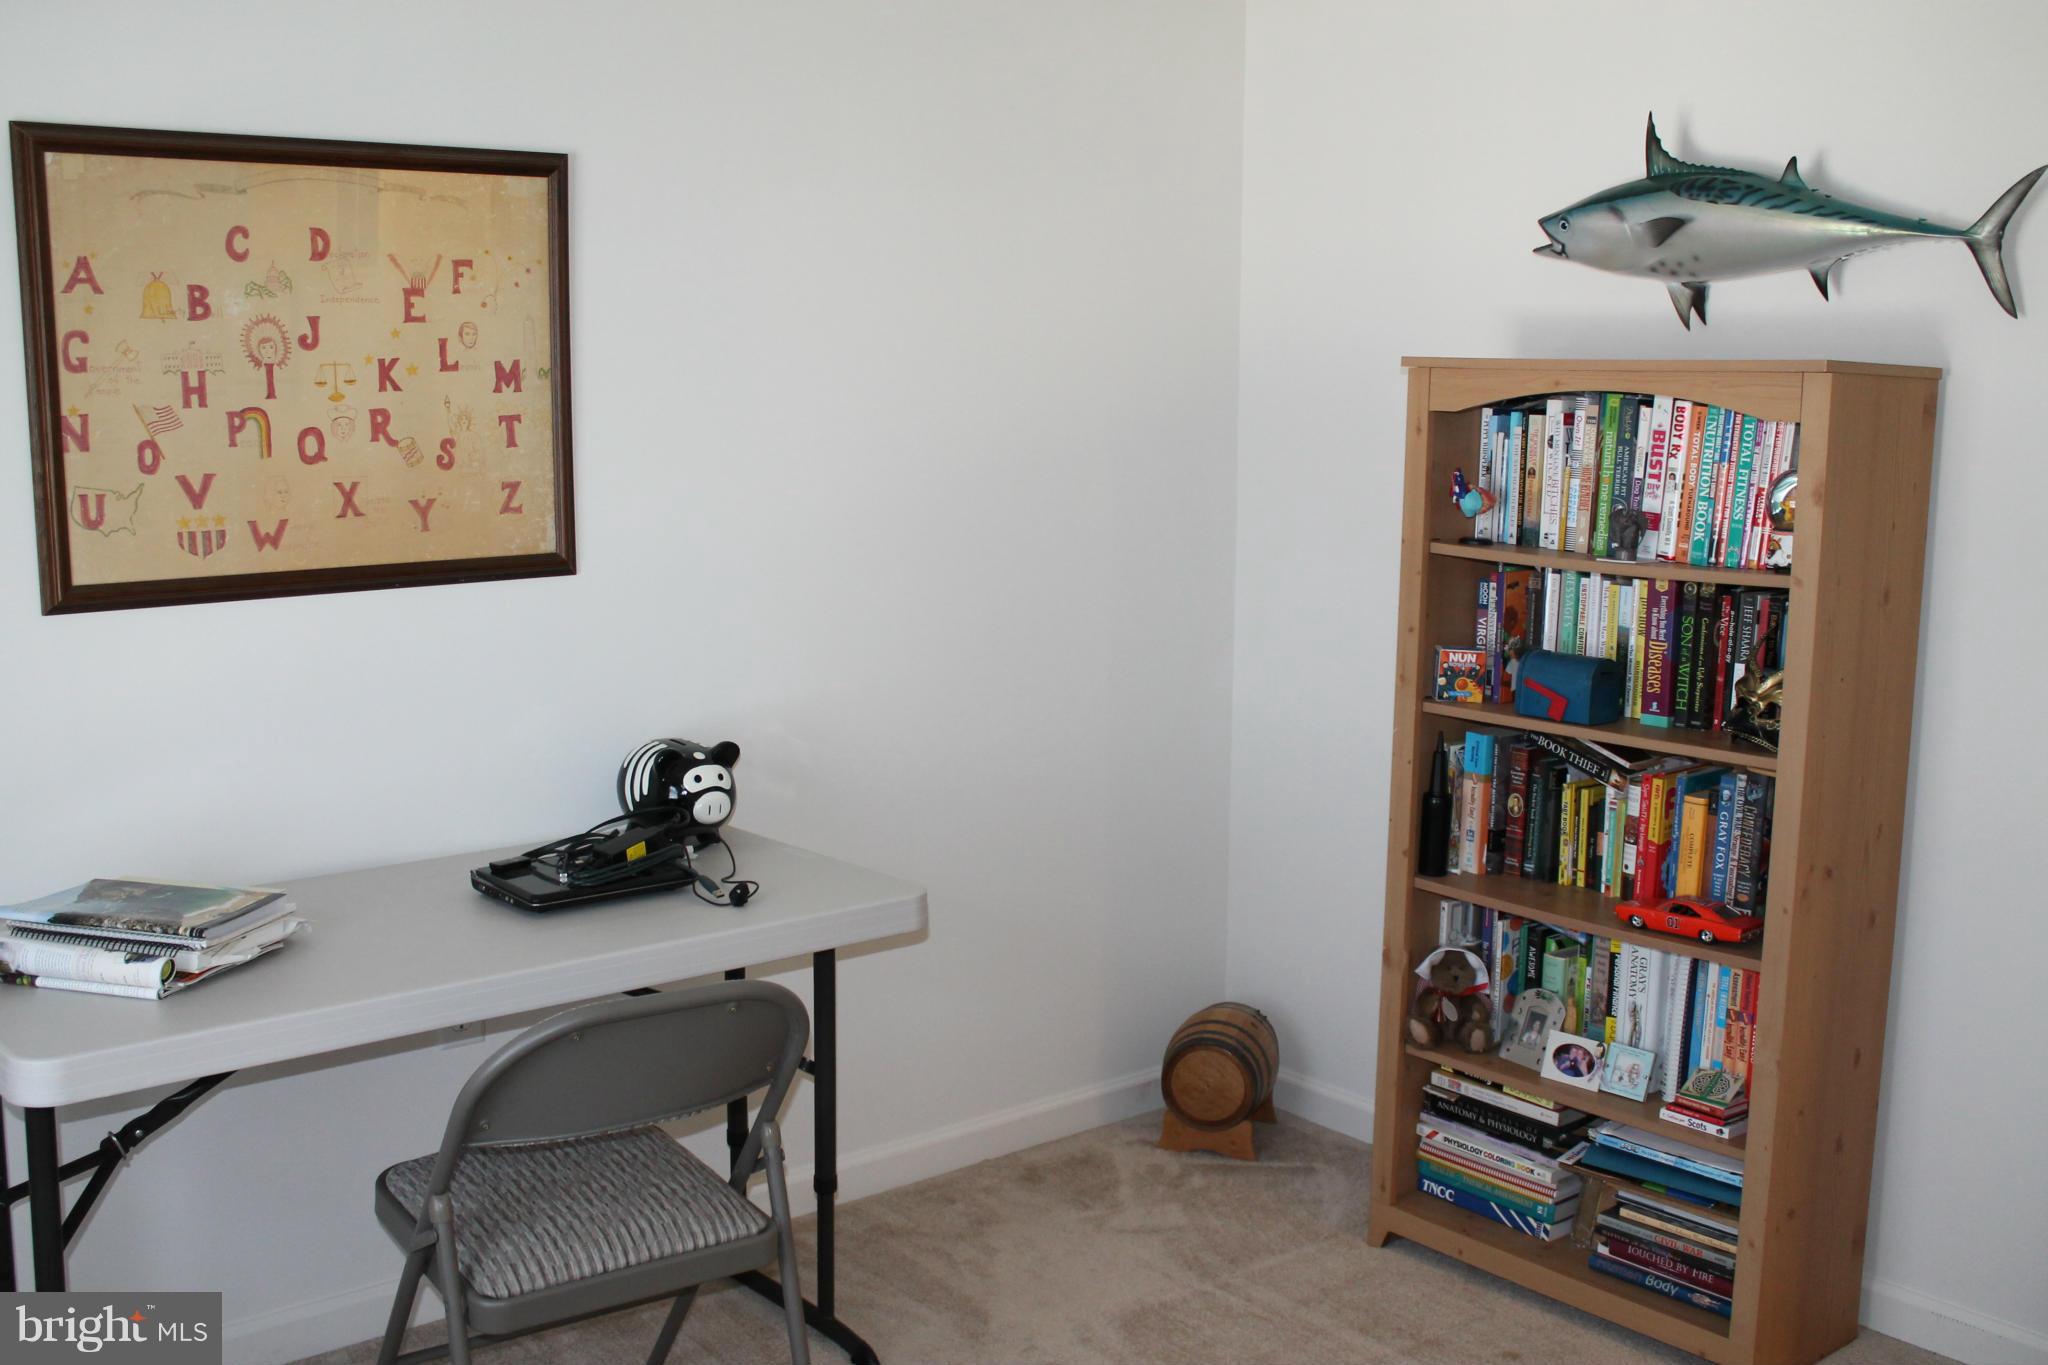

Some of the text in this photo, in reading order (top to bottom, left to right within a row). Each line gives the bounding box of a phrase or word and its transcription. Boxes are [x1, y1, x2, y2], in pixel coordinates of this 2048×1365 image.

[225, 225, 250, 262] C
[309, 227, 330, 261] D
[61, 256, 104, 294] A
[451, 259, 473, 294] F
[187, 284, 212, 321] B
[403, 288, 426, 323] E
[62, 330, 89, 373] G
[298, 316, 320, 351] J
[438, 338, 459, 372] L
[182, 370, 208, 408] H
[264, 363, 277, 399] I
[377, 358, 402, 392] K
[493, 359, 522, 393] M
[62, 414, 90, 453] N
[226, 411, 247, 447] P
[369, 408, 399, 447] R
[498, 414, 521, 448] T
[1673, 406, 1686, 439] BODY
[138, 440, 160, 475] O
[297, 426, 328, 465] Q
[436, 438, 457, 471] S
[1603, 431, 1614, 468] natural
[1649, 430, 1665, 482] BUST
[1691, 432, 1700, 460] TOTAL
[1689, 463, 1697, 487] BODY
[1694, 420, 1716, 541] NUTRITION BOOK
[1733, 423, 1755, 520] TOTAL FITNESS
[175, 473, 217, 510] V
[333, 481, 365, 518] X
[499, 481, 523, 514] Z
[1550, 479, 1558, 525] BITCHES
[1684, 488, 1693, 531] TURNAROUND
[79, 494, 105, 530] U
[409, 498, 437, 532] Y
[1597, 503, 1607, 550] remedies
[248, 519, 288, 551] W
[1563, 573, 1576, 627] MESSAGES
[1579, 584, 1587, 625] UNSTOPPABLE
[1658, 596, 1668, 640] Everything You Need
[1487, 597, 1497, 658] PENNSYLVANIA
[1650, 627, 1658, 640] about
[1681, 616, 1693, 647] SON
[1720, 617, 1728, 636] Vice
[1740, 605, 1754, 661] JEFF SHAARA
[1449, 653, 1477, 662] NUN
[1646, 641, 1667, 693] Diseases
[1696, 668, 1705, 680] Ugly
[1675, 664, 1689, 710] WITCH
[1538, 736, 1601, 775] BOOK THIEF
[1736, 799, 1744, 814] CIVIL
[1737, 786, 1745, 798] THE
[1718, 811, 1729, 842] GRAY
[1738, 805, 1757, 878] CONFEDERACY
[1687, 833, 1695, 869] COMPLETE
[1715, 847, 1726, 869] FOX
[1731, 834, 1739, 856] Strange
[1666, 916, 1680, 929] 01
[1528, 946, 1536, 979] AWESOME
[1628, 947, 1639, 1000] ANATOMY
[1638, 957, 1648, 993] GRAY'S
[1730, 973, 1741, 1007] Assessment
[1437, 1102, 1538, 1144] ANATOMY & PHYSIOLOGY
[1688, 1118, 1707, 1131] Scots
[1443, 1136, 1535, 1176] PHYSIOLOGY COLORING BOOK
[1422, 1179, 1455, 1202] TNCC
[1627, 1245, 1714, 1284] TOUCHED BY FIRE
[1655, 1235, 1704, 1258] CIVIL WAR
[1645, 1275, 1679, 1295] Body
